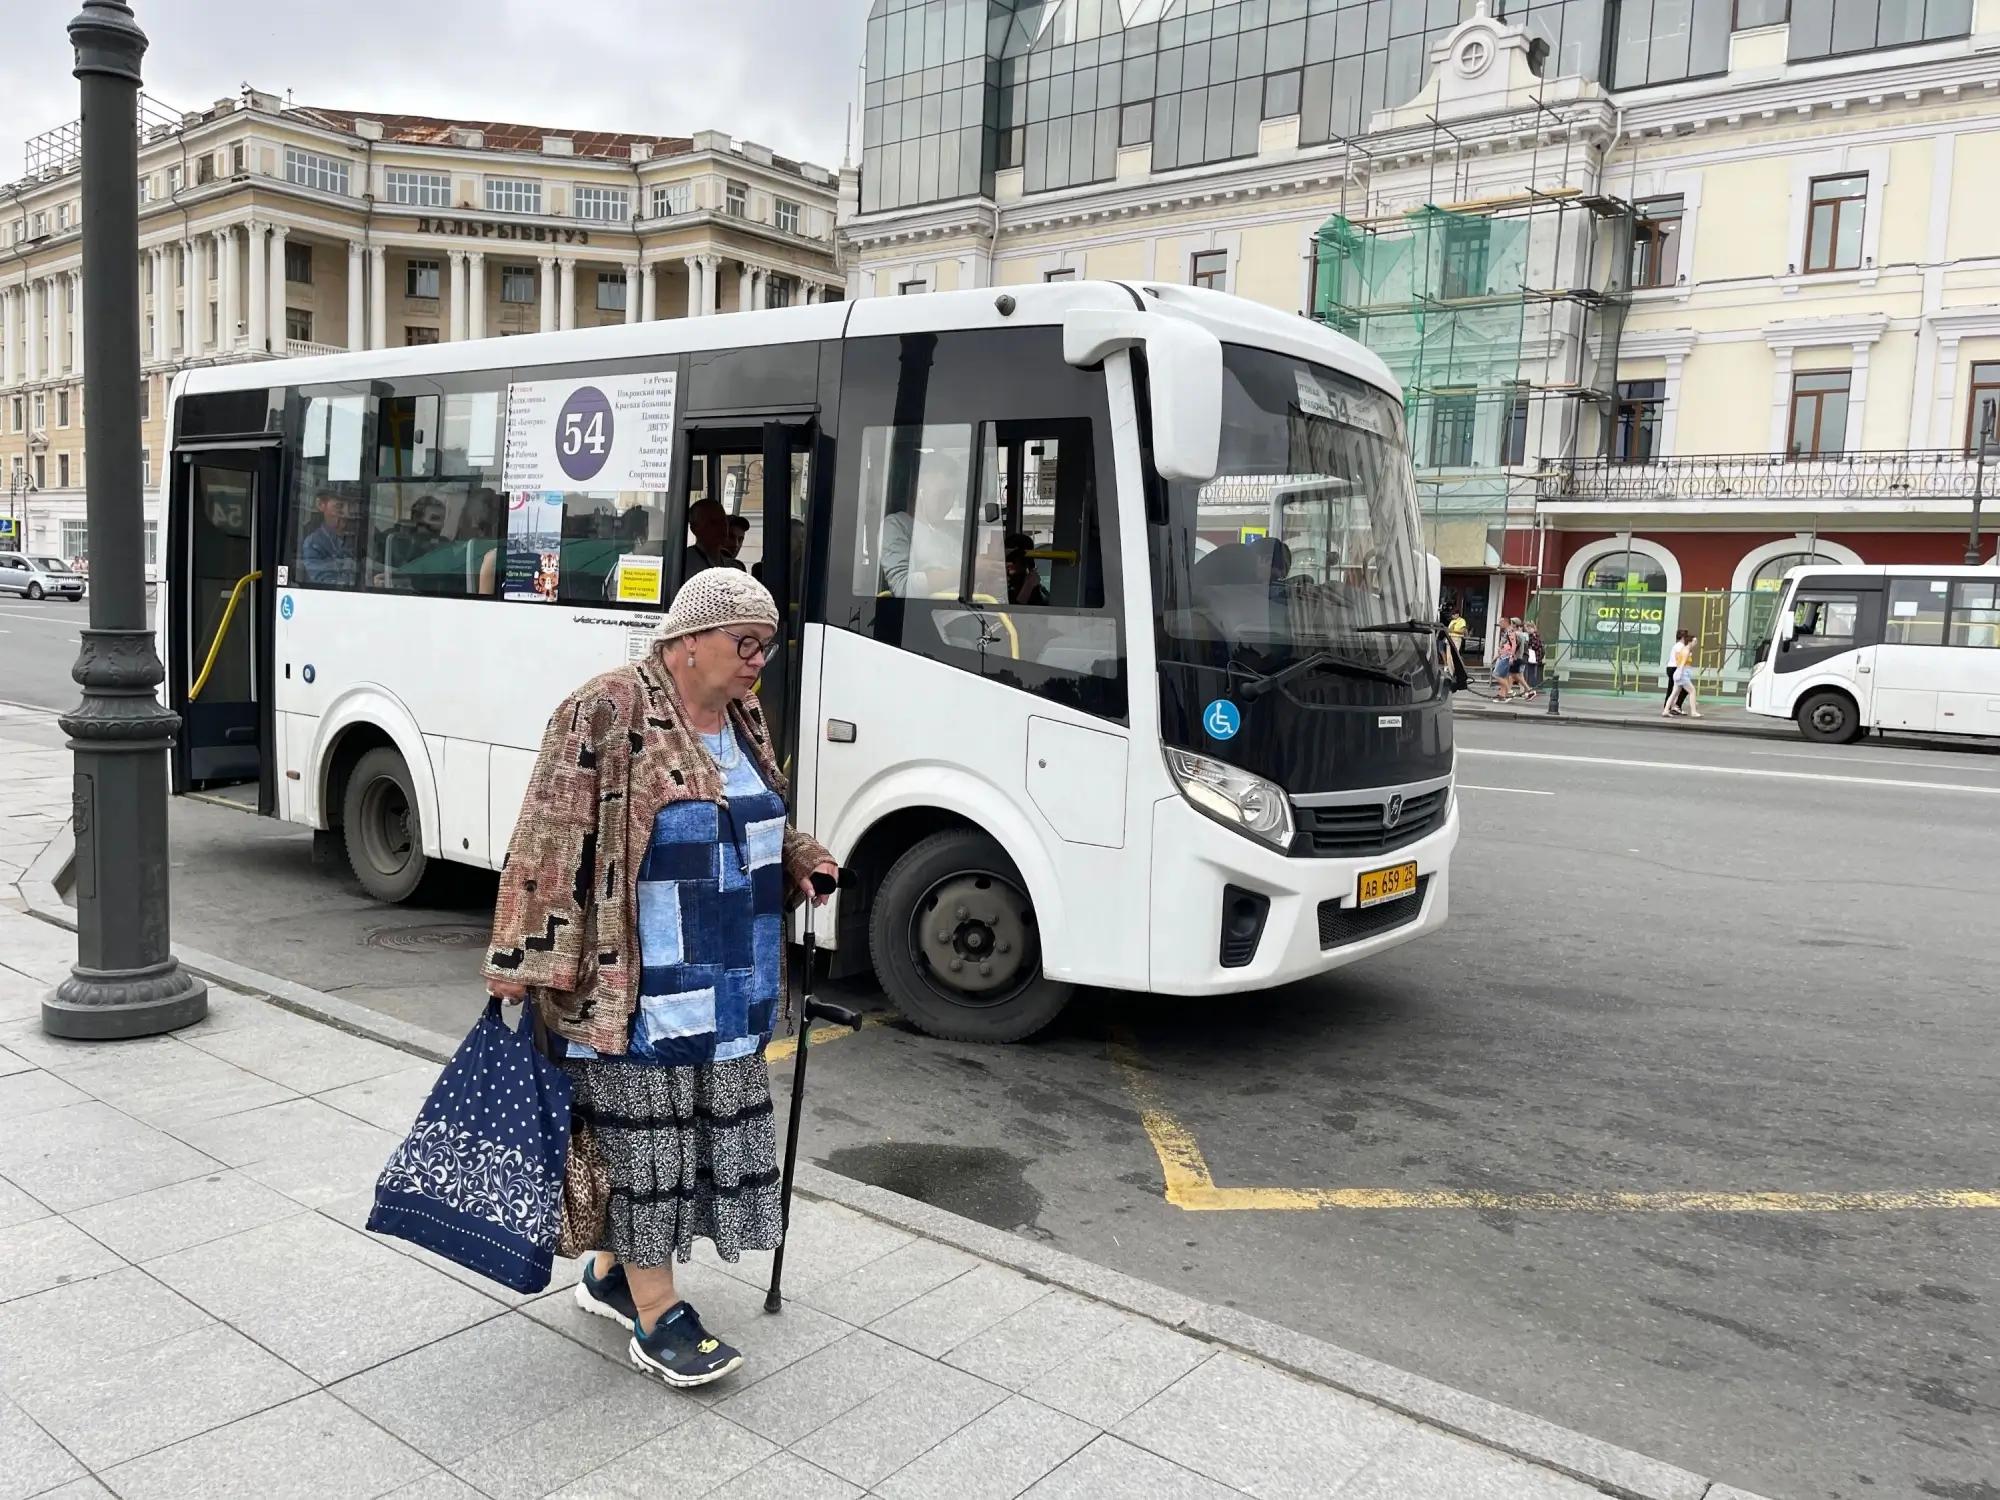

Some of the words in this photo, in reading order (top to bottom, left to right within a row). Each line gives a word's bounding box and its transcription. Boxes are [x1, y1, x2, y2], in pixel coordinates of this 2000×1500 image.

[417, 217, 590, 245] ДАЛЬРЫБВТУЗ
[654, 376, 673, 384] Речка
[617, 388, 655, 399] Покровский
[656, 388, 672, 398] парк
[615, 401, 640, 410] Красная
[641, 400, 672, 409] больница
[642, 412, 670, 420] Площадь
[646, 422, 669, 432] ДВГТУ
[562, 411, 606, 456] 54
[651, 434, 668, 444] Цирк
[638, 446, 668, 456] Авангард
[640, 459, 667, 470] Луговая
[628, 470, 667, 481] Спортивная
[640, 481, 667, 489] Луговая
[1597, 607, 1663, 621] аптека
[1382, 869, 1400, 894] 659
[1404, 865, 1413, 882] 25
